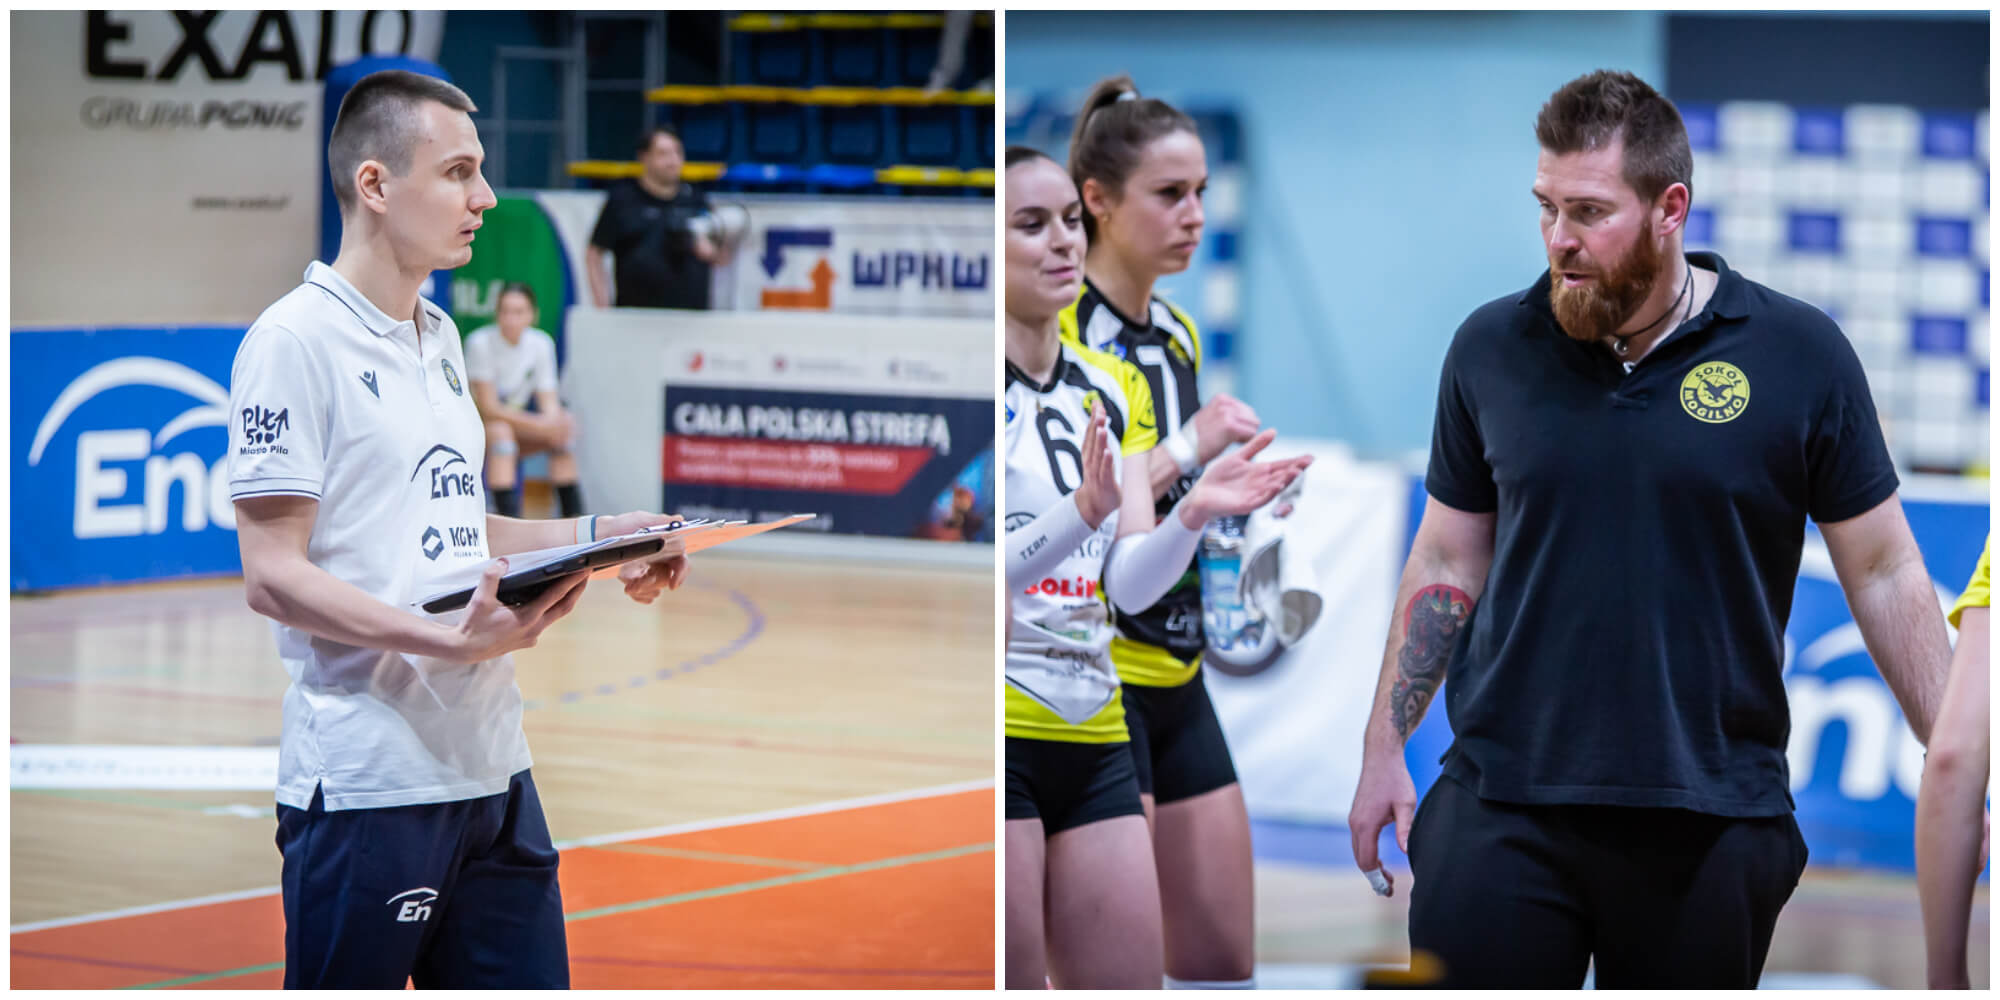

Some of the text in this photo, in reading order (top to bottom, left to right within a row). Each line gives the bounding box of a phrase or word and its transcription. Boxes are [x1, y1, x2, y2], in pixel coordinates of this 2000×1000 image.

[1136, 345, 1181, 440] 7
[1684, 388, 1744, 419] MOGILNO
[747, 406, 849, 441] POLSKA
[1036, 407, 1084, 496] 6
[1020, 534, 1048, 560] TEAM
